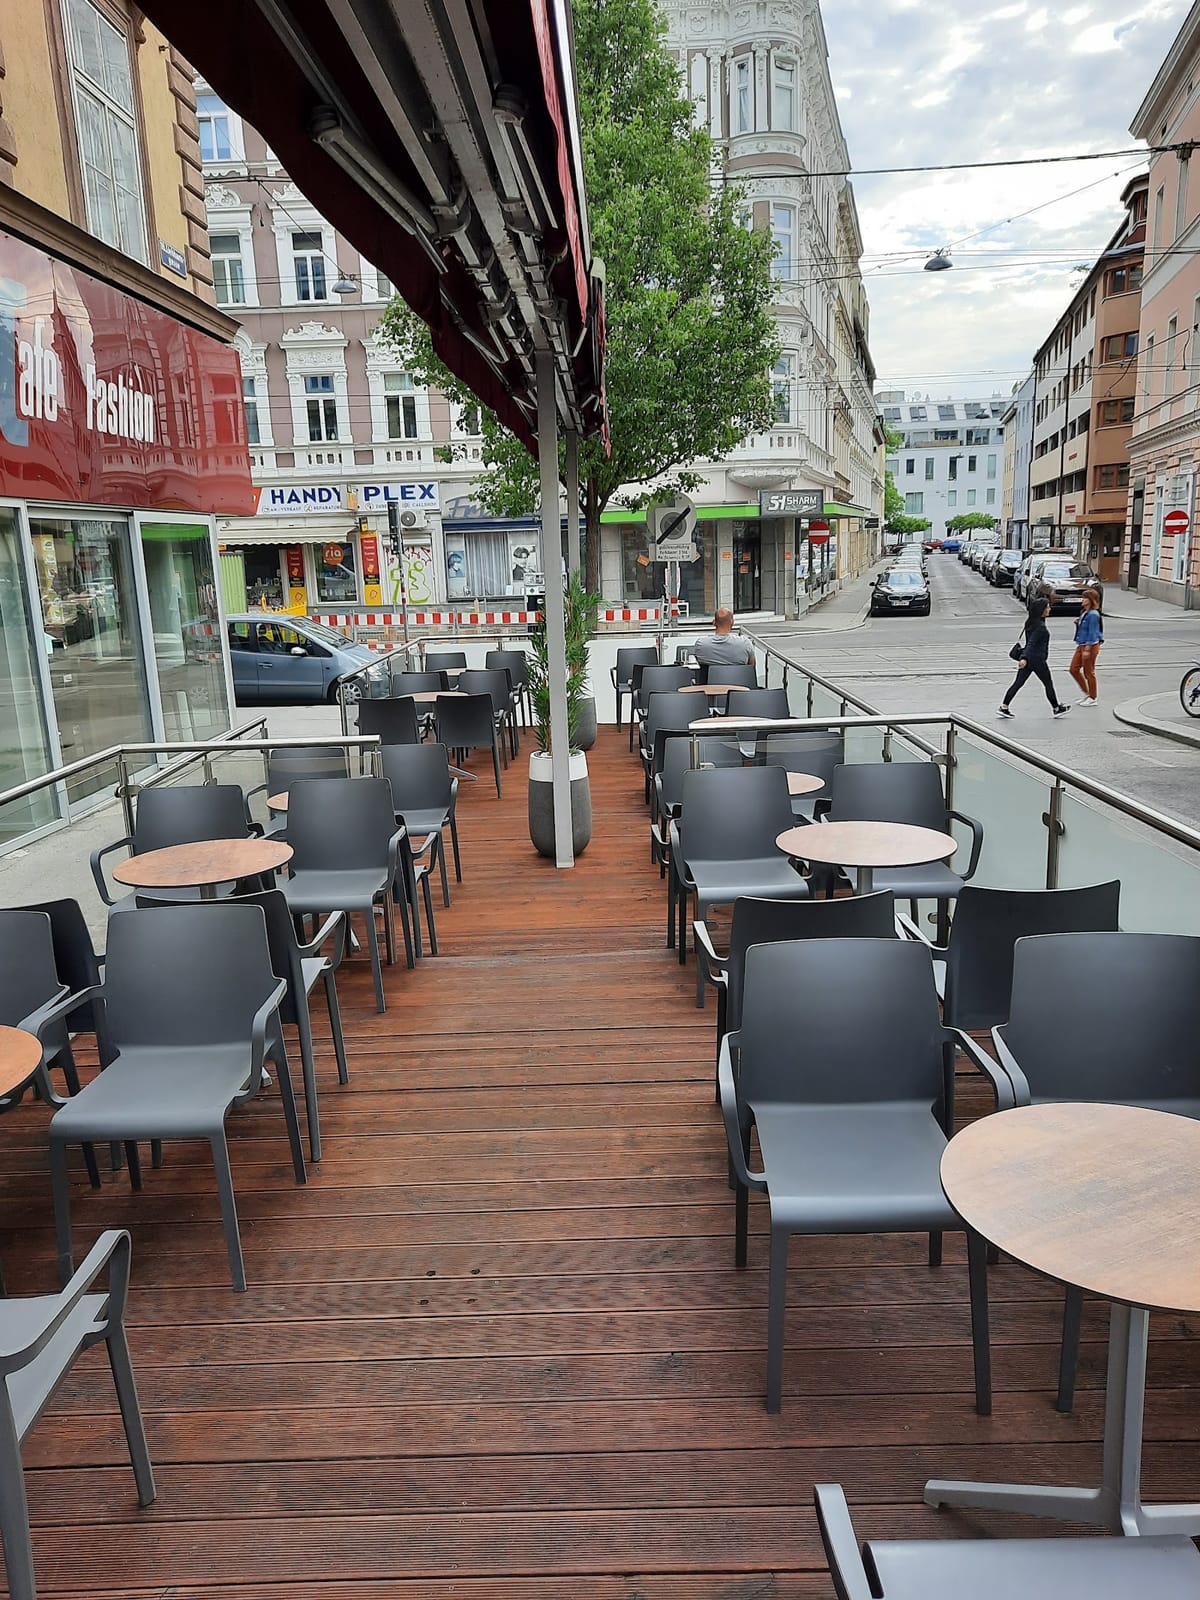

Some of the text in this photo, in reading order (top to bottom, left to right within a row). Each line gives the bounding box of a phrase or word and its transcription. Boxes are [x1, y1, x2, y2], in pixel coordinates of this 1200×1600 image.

[86, 363, 154, 443] Fashion
[271, 484, 435, 504] HANDY PLEX
[787, 496, 817, 505] SHARM
[325, 546, 342, 557] ria
